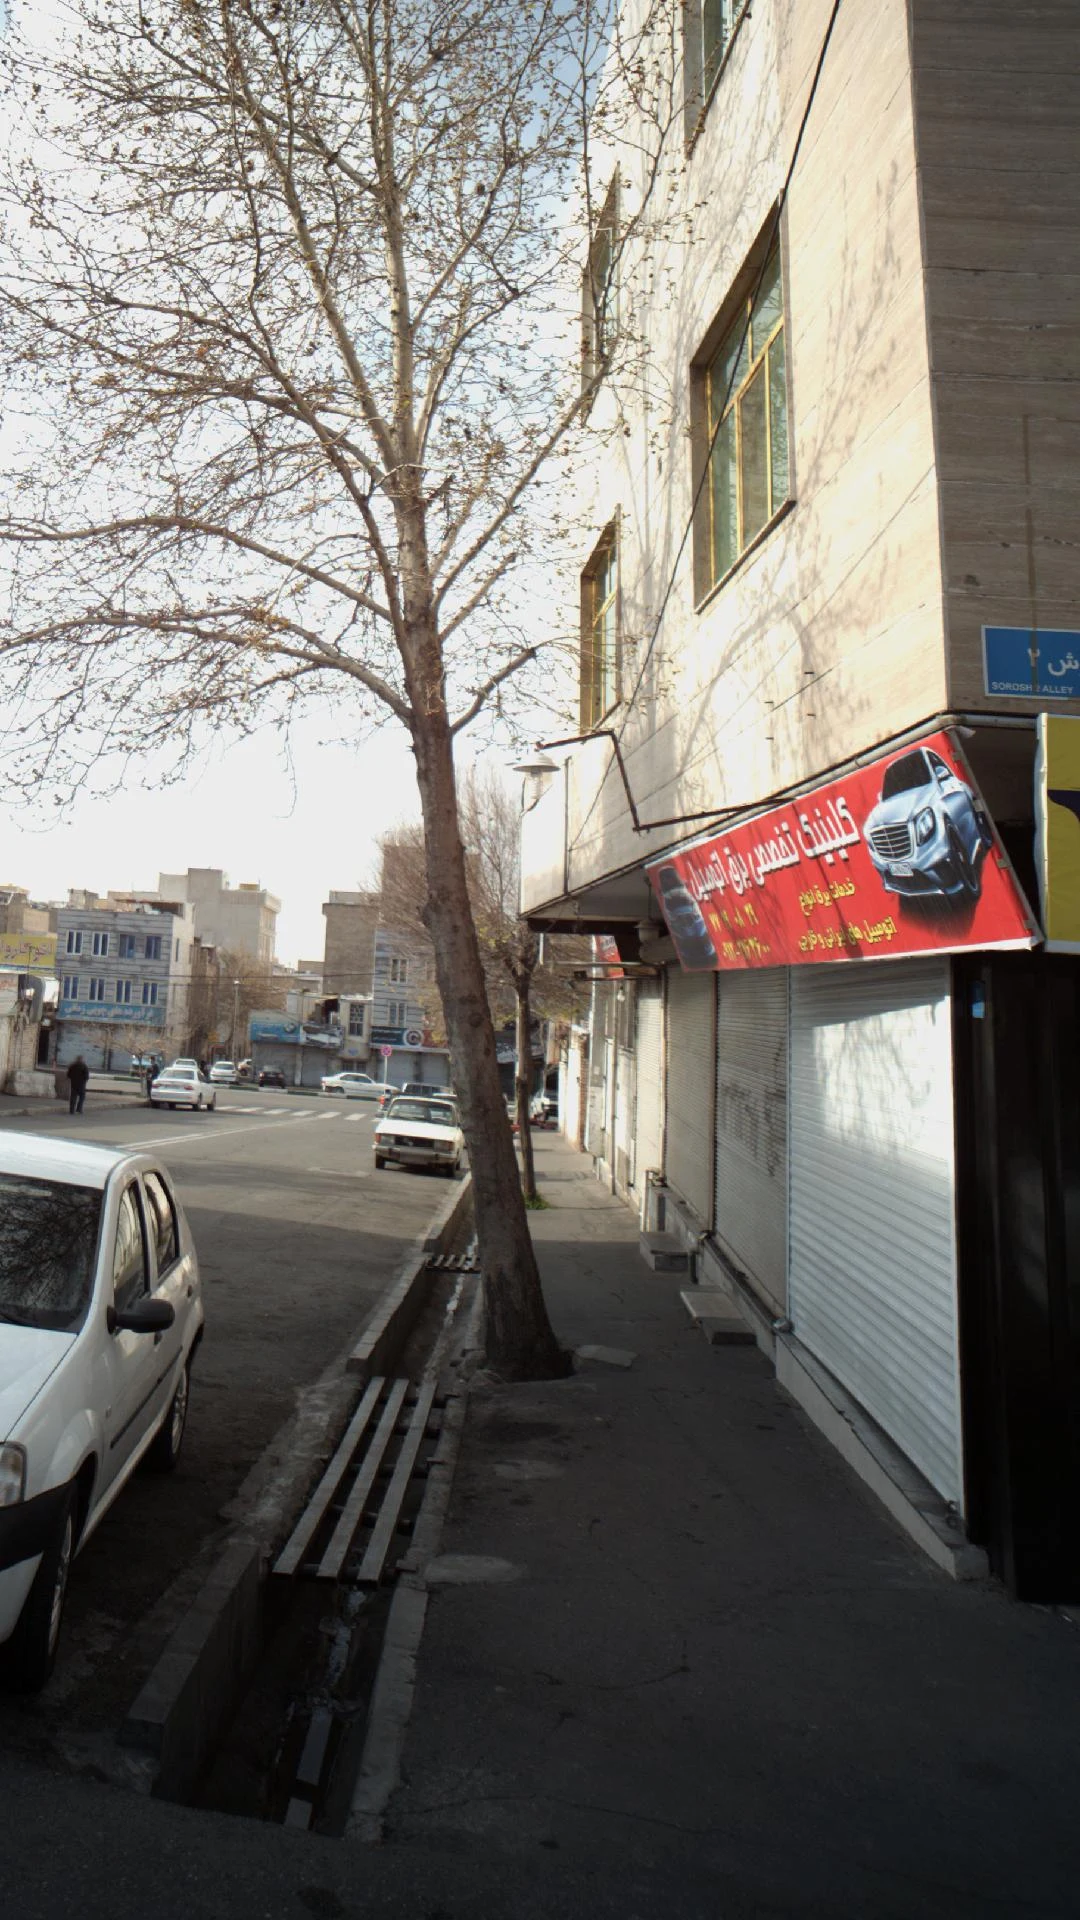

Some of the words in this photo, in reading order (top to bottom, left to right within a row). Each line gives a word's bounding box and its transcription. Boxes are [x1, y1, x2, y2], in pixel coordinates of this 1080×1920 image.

[1042, 684, 1074, 694] ALLEY
[796, 796, 860, 865] کلینیک
[728, 848, 753, 894] برق
[748, 822, 800, 886] تخصصی
[687, 850, 729, 901] اتومبیل
[829, 877, 855, 899] خدمات
[814, 884, 832, 907] برق
[862, 916, 897, 944] اتومبیل
